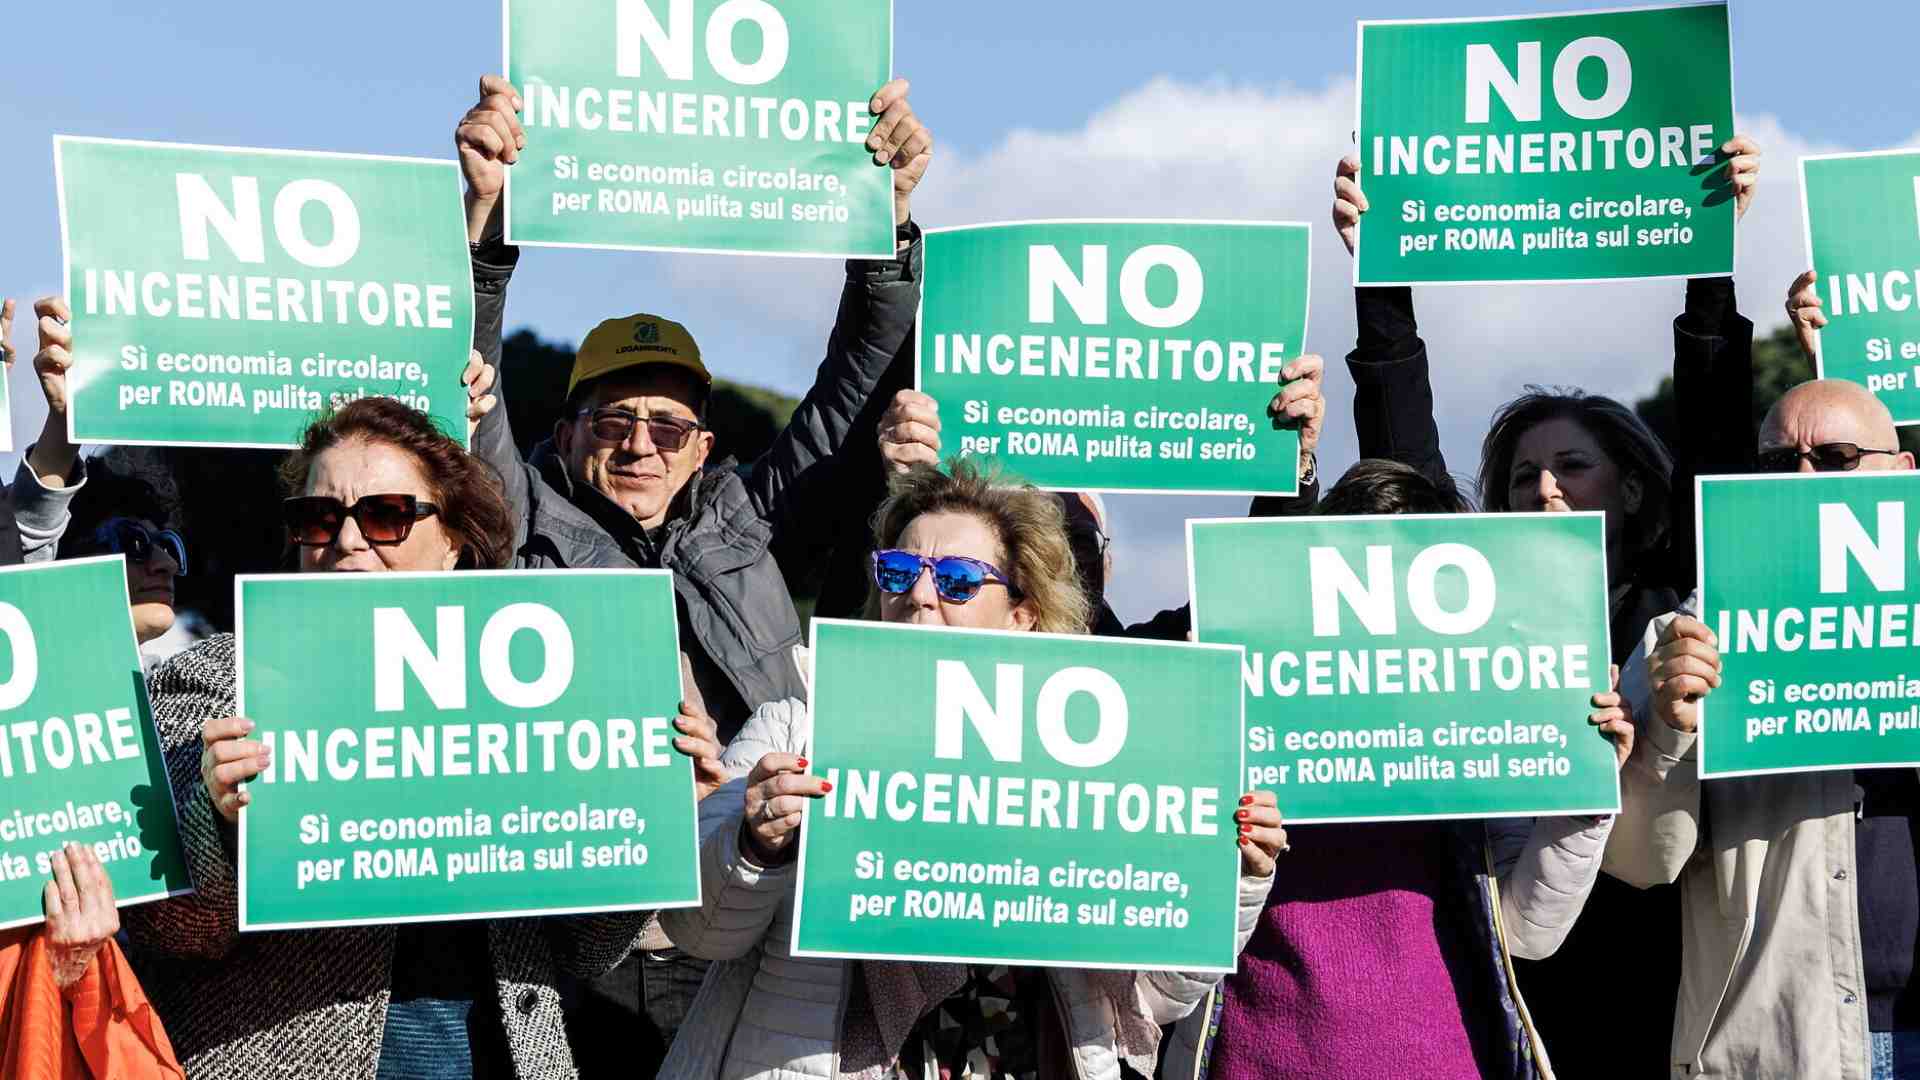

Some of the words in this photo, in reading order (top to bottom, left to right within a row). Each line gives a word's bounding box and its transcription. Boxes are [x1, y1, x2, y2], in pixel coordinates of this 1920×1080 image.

[616, 0, 788, 84] NO
[1465, 37, 1632, 123] NO
[523, 83, 869, 143] INCENERITORE
[1374, 125, 1715, 175] INCENERITORE
[554, 155, 578, 179] Sì
[588, 163, 714, 186] economia
[722, 165, 848, 196] circolare,
[176, 173, 360, 267] NO
[553, 192, 591, 215] per
[599, 189, 670, 214] ROMA
[676, 194, 742, 220] pulita
[750, 197, 784, 219] sul
[792, 199, 849, 223] serio
[1402, 200, 1425, 222] Sì
[1435, 199, 1560, 221] economia
[1569, 195, 1691, 219] circolare,
[1400, 235, 1437, 256] per
[1445, 228, 1515, 250] ROMA
[1523, 227, 1588, 255] pulita
[1596, 225, 1629, 247] sul
[1637, 223, 1693, 246] serio
[85, 268, 451, 328] INCENERITORE
[1029, 245, 1203, 327] NO
[1830, 269, 1920, 315] INC
[121, 345, 147, 370] Sì
[157, 351, 292, 375] economia
[301, 352, 428, 386] circolare,
[935, 334, 1283, 383] INCENERITORE
[1866, 338, 1892, 361] Sì
[1901, 342, 1920, 359] e
[120, 385, 161, 410] per
[170, 380, 245, 407] ROMA
[253, 384, 322, 413] pulita
[372, 389, 430, 413] rio
[1868, 373, 1907, 394] per
[964, 400, 988, 423] Sì
[998, 405, 1125, 427] economia
[1134, 406, 1255, 435] circolare,
[961, 437, 1000, 458] per
[1008, 432, 1078, 456] ROMA
[1086, 435, 1152, 462] pulita
[1160, 437, 1193, 459] sul
[1200, 438, 1255, 460] serio
[1819, 501, 1920, 593] N
[1310, 544, 1496, 636] NO
[1718, 604, 1920, 653] INCENE
[374, 603, 574, 711] NO
[1243, 644, 1591, 697] NCENERITORE
[935, 660, 1128, 767] NO
[1749, 680, 1774, 704] Sì
[1248, 727, 1274, 752] Sì
[1285, 722, 1424, 750] economia
[1433, 720, 1567, 748] circolare,
[1746, 717, 1788, 742] per
[1795, 707, 1871, 733] ROMA
[1879, 705, 1920, 735] pul
[261, 717, 671, 783] INCENERITORE
[1248, 765, 1289, 790] per
[1297, 757, 1375, 783] ROMA
[1383, 755, 1455, 787] pulita
[1464, 753, 1499, 778] sul
[1508, 752, 1570, 777] serio
[0, 801, 133, 842] circolare,
[300, 814, 329, 844] Sì
[340, 808, 491, 842] economia
[502, 803, 645, 834] circolare,
[823, 768, 1218, 835] INCENERITORE
[93, 832, 142, 863] erio
[298, 859, 344, 889] per
[354, 848, 438, 879] ROMA
[447, 845, 524, 881] pulita
[534, 841, 572, 870] sul
[582, 838, 648, 867] serio
[855, 851, 884, 879] Sì
[894, 859, 1039, 886] economia
[1049, 861, 1188, 898] circolare,
[850, 895, 896, 921] per
[904, 890, 984, 920] ROMA
[993, 895, 1068, 927] pulita
[1077, 899, 1116, 925] sul
[1124, 901, 1189, 928] serio
